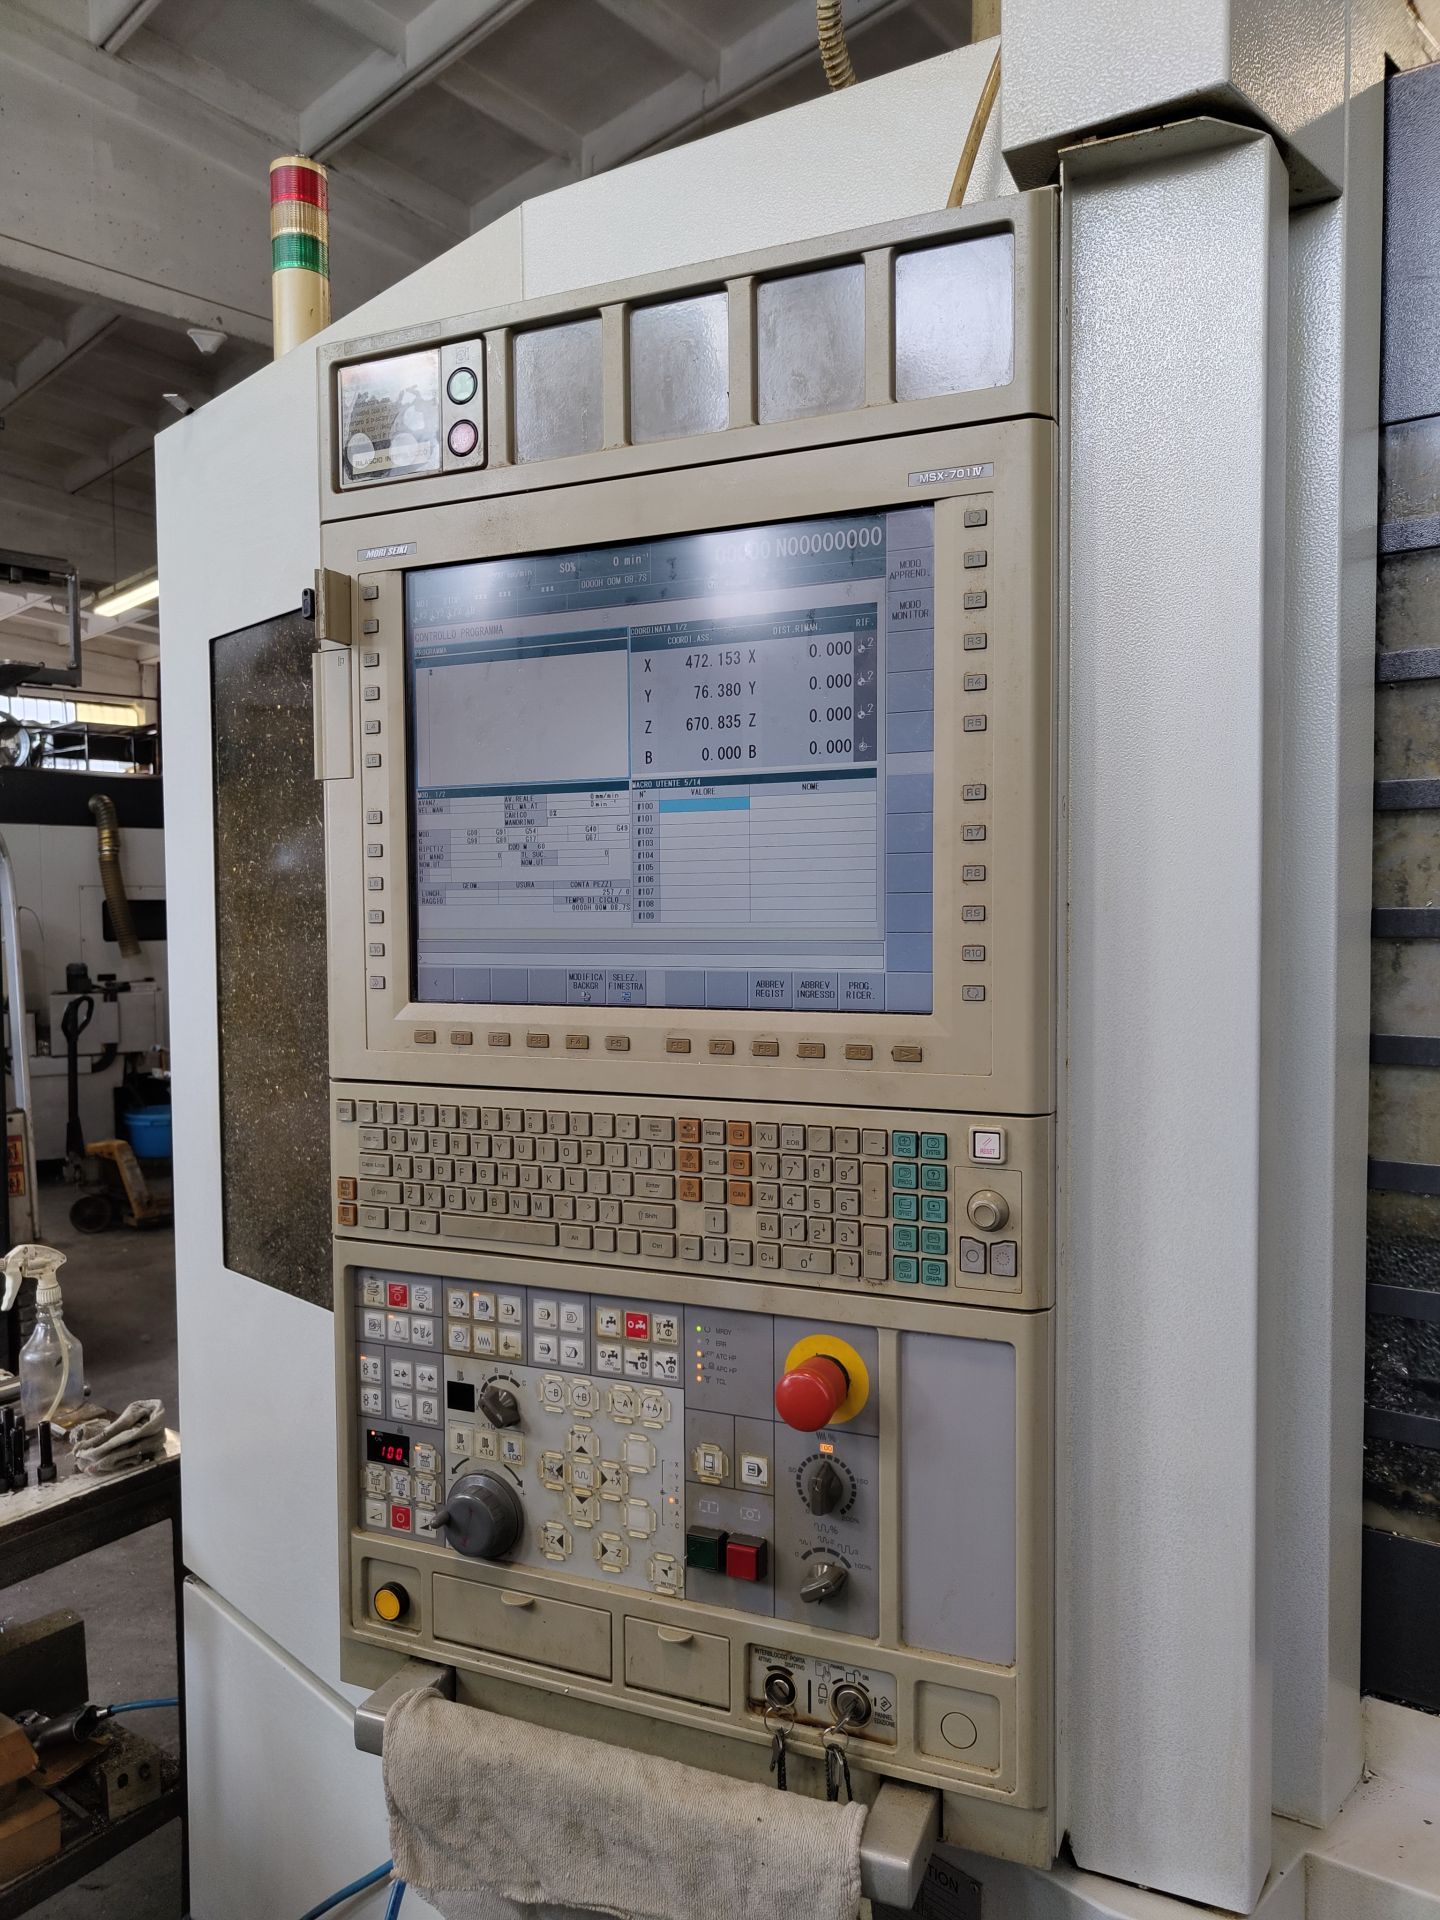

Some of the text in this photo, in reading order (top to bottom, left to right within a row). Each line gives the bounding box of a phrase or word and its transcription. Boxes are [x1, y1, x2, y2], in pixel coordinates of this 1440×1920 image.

[776, 526, 882, 558] N00000000
[366, 545, 408, 559] MORI SEIKI
[900, 558, 921, 569] MODO
[967, 553, 981, 564] R1
[889, 567, 931, 580] APPREND.
[581, 578, 603, 588] 0000H
[607, 577, 621, 586] 00M
[967, 594, 982, 605] R2
[900, 600, 921, 610] MODO
[891, 609, 929, 621] MONITOR
[414, 624, 504, 642] CONTROLLO PROGRAMMA
[630, 623, 687, 635] COORDINATA 1/2
[667, 634, 713, 645] COORDI.ASS.
[855, 617, 874, 628] RIF.
[967, 636, 982, 646] R3
[415, 647, 447, 656] PROGRAMMA
[644, 640, 852, 672] X 472.153 X 0.000
[967, 677, 982, 687] R4
[644, 673, 852, 703] Y 76.380 Y 0.000
[644, 706, 852, 734] Z 670.835 Z 0.000
[967, 719, 982, 728] R5
[645, 738, 852, 764] B 0.000 B 0.000
[632, 779, 701, 789] MACRO UTENTE 5/14
[691, 782, 819, 796] VALORE NOME
[966, 787, 981, 797] R6
[637, 802, 654, 810] #100
[637, 815, 654, 823] #101
[637, 827, 654, 835] #102
[966, 828, 980, 837] R7
[637, 839, 654, 847] #103
[637, 851, 654, 859] #104
[637, 863, 654, 871] #105
[966, 868, 980, 878] R8
[637, 875, 654, 883] #106
[637, 888, 654, 896] #107
[637, 900, 654, 908] #108
[637, 912, 654, 920] #109
[965, 909, 980, 918] R9
[369, 946, 381, 954] L10
[964, 948, 981, 958] R10
[569, 973, 638, 982] MODIFICA SELEZ.
[573, 982, 644, 991] BACKGR FINESTRA
[756, 980, 873, 990] ABBREV ABBREV PROG.
[755, 990, 876, 1000] REGIST INGRESSO RICER.
[492, 1035, 503, 1043] F2
[570, 1038, 581, 1047] F4
[787, 1167, 794, 1176] 7
[813, 1168, 820, 1178] 8
[840, 1171, 847, 1180] 9
[786, 1199, 794, 1207] 4
[813, 1199, 820, 1208] 5
[840, 1202, 848, 1211] 6
[788, 1227, 793, 1237] 1
[813, 1229, 821, 1239] 2
[840, 1232, 848, 1242] 3
[800, 1259, 808, 1268] 0
[381, 1445, 403, 1461] 100
[789, 1654, 806, 1664] PORTA
